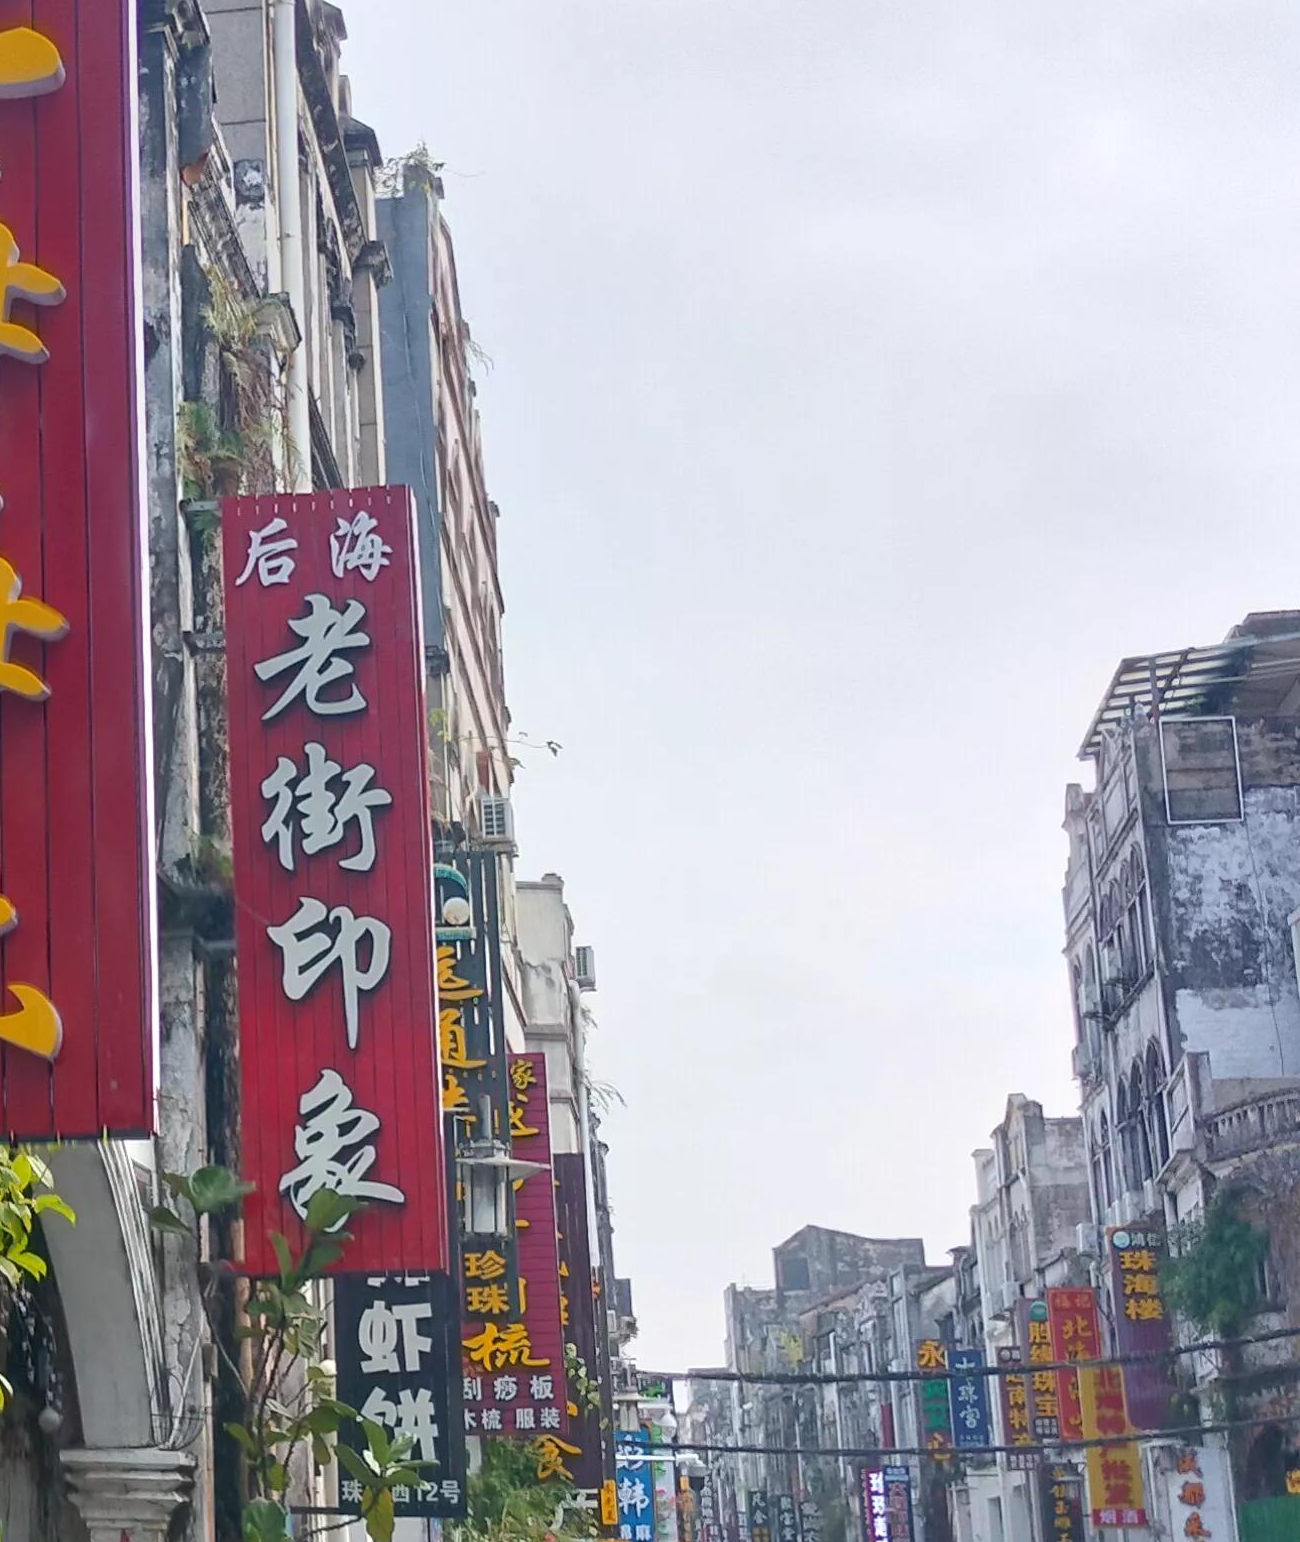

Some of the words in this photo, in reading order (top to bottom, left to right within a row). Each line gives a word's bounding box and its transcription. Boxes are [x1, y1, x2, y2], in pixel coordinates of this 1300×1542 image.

[235, 511, 392, 586] 后海
[253, 593, 405, 1234] 老街印象
[465, 1249, 509, 1314] 珍珠
[358, 1276, 440, 1461] 虾饼
[516, 1408, 561, 1429] 服装
[341, 1482, 461, 1504] 珠西12号
